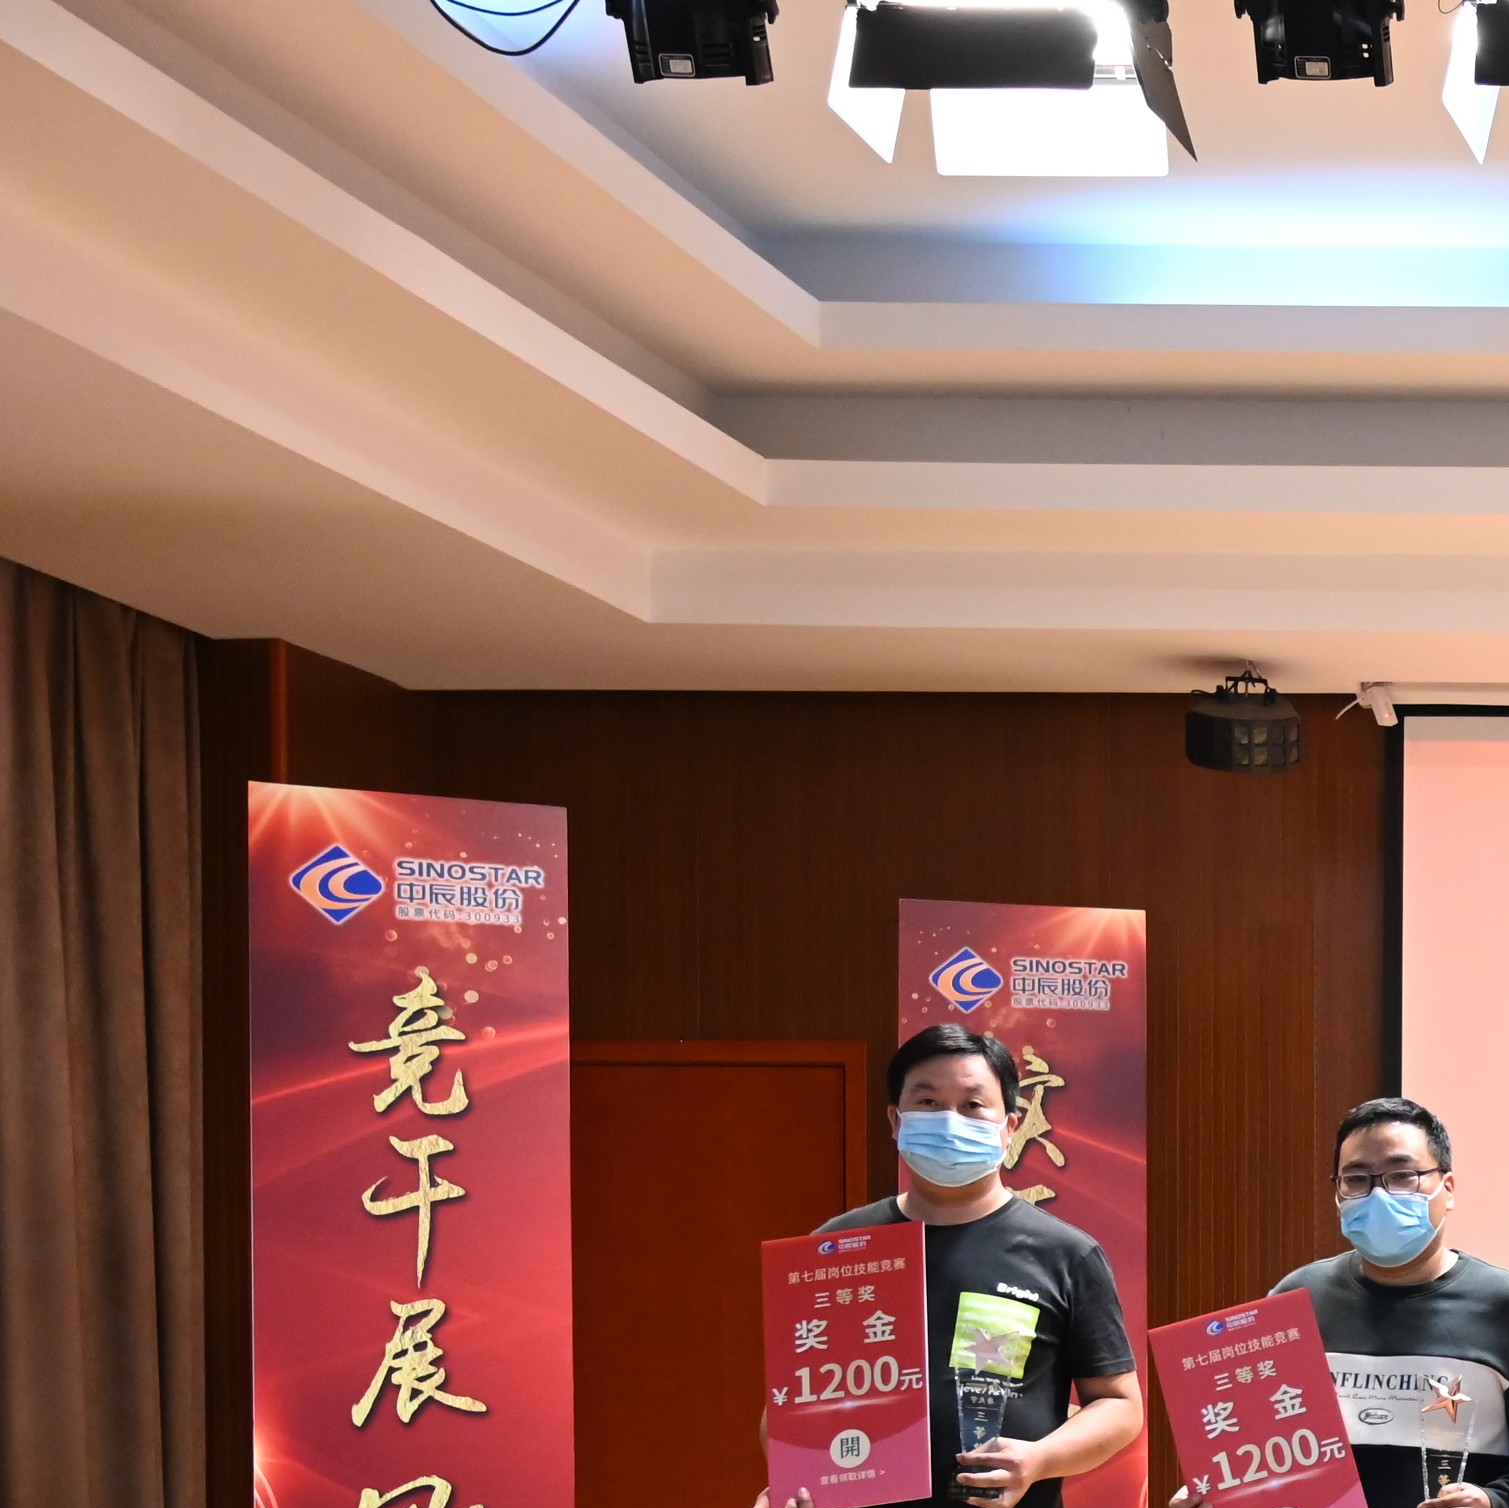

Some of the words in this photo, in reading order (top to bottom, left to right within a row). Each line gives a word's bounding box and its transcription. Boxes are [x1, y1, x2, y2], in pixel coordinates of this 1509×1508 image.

[397, 860, 543, 886] SINOSTAR
[397, 882, 521, 910] 中辰股份
[1012, 959, 1126, 977] SINOSTAR
[1012, 977, 1109, 997] 中辰股份
[788, 1258, 906, 1285] 第七届岗位技能竞赛
[814, 1285, 876, 1308] 三等奖
[794, 1310, 896, 1353] 奖金
[1181, 1327, 1301, 1371] 第七届岗位技能竞赛
[1213, 1360, 1277, 1391] 三等奖
[1330, 1372, 1449, 1392] NFLINCHIN
[1201, 1383, 1307, 1439] 奖金
[840, 1435, 861, 1459] 開
